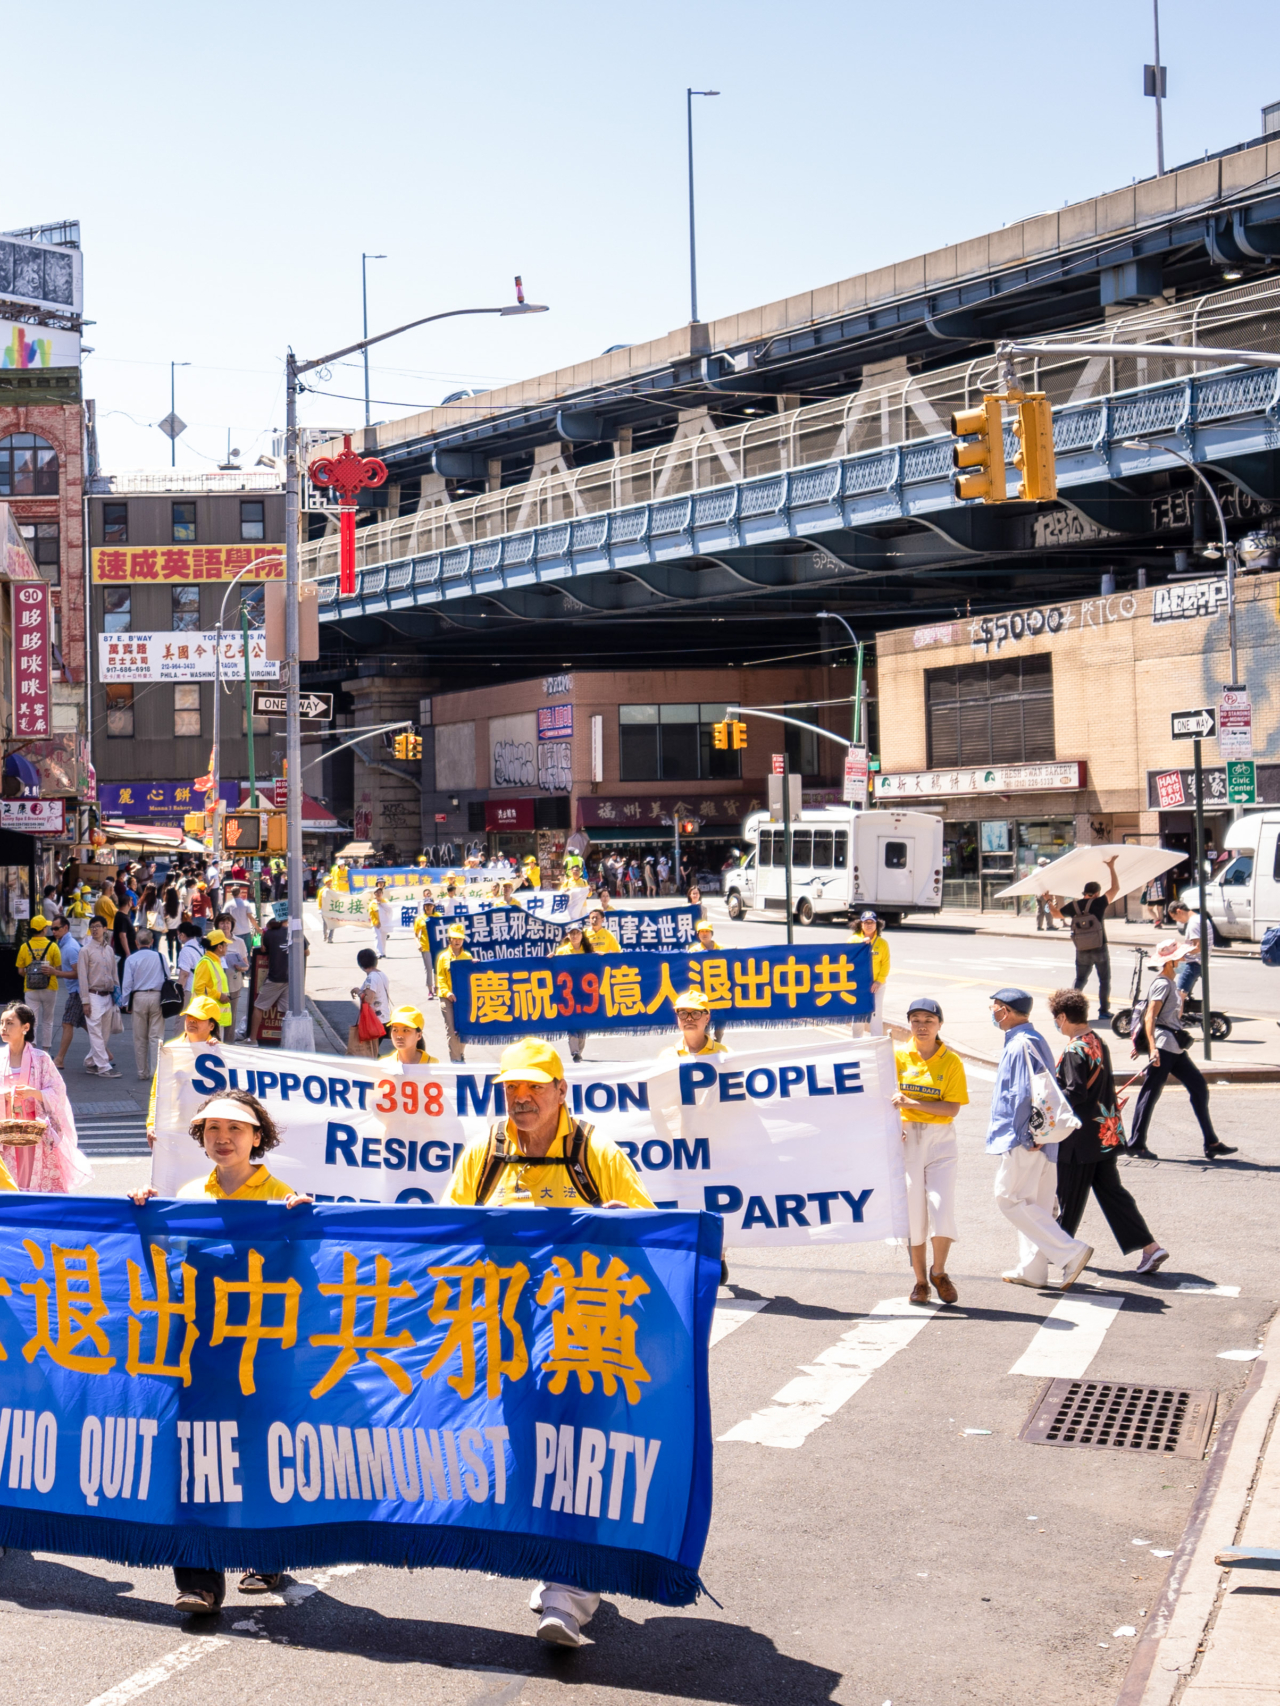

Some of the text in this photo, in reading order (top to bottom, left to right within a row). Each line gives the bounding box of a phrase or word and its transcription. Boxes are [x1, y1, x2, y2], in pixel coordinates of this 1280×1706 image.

[97, 546, 285, 581] 速成英語學院
[23, 590, 39, 602] 90
[108, 656, 148, 665] 巴士公司
[264, 698, 287, 710] ONE
[1177, 718, 1209, 732] ONE WAY
[1024, 767, 1042, 778] SWAN
[1045, 765, 1072, 776] BAKERY
[1159, 774, 1179, 787] HAK
[1230, 784, 1254, 792] Center
[1162, 793, 1182, 806] BOX
[471, 946, 495, 961] The
[495, 944, 523, 959] Most
[525, 942, 544, 957] Evil
[191, 1053, 375, 1111] SUPPORT
[376, 1079, 445, 1117] 398
[679, 1060, 865, 1106] PEOPLE
[620, 1137, 711, 1172] ROM
[704, 1184, 875, 1230] PARTY
[79, 1416, 158, 1507] QUIT
[176, 1420, 244, 1504] THE
[269, 1420, 510, 1505] COMMUNIST
[532, 1420, 661, 1525] PARTY
